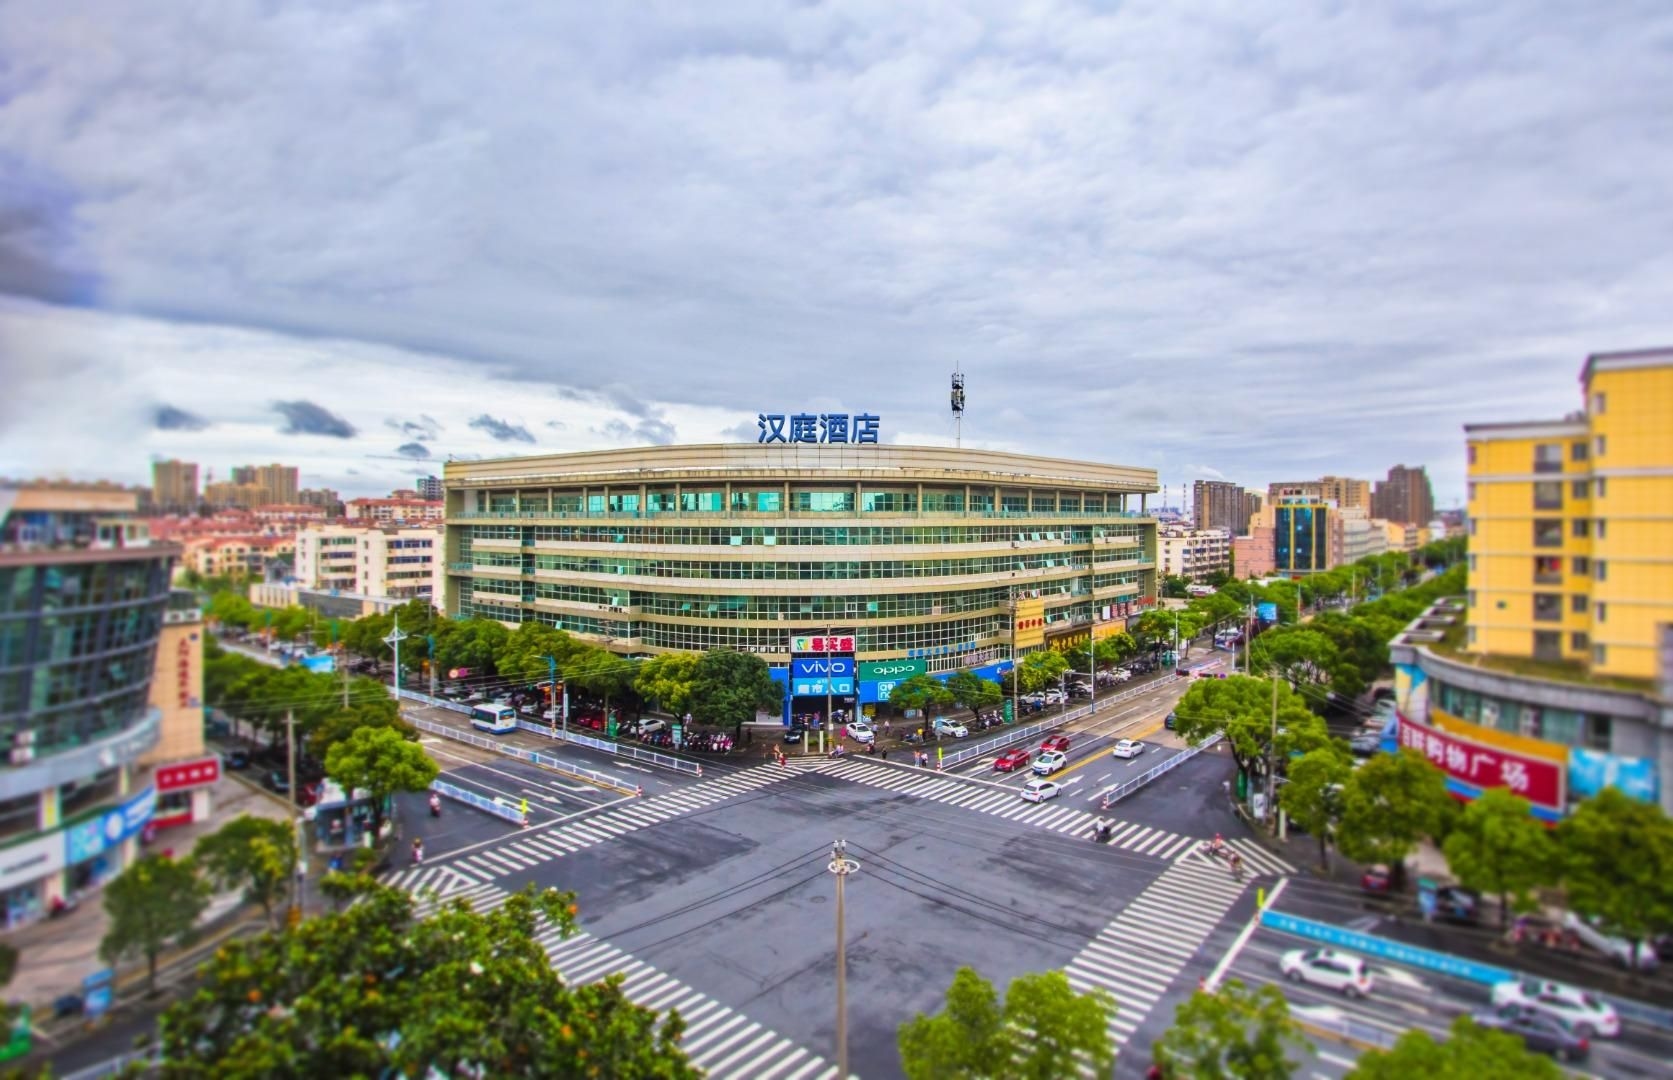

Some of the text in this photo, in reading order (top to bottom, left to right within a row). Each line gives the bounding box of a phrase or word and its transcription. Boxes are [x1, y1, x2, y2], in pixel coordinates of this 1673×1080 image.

[758, 412, 880, 444] 汉庭酒店
[873, 665, 915, 675] oppo
